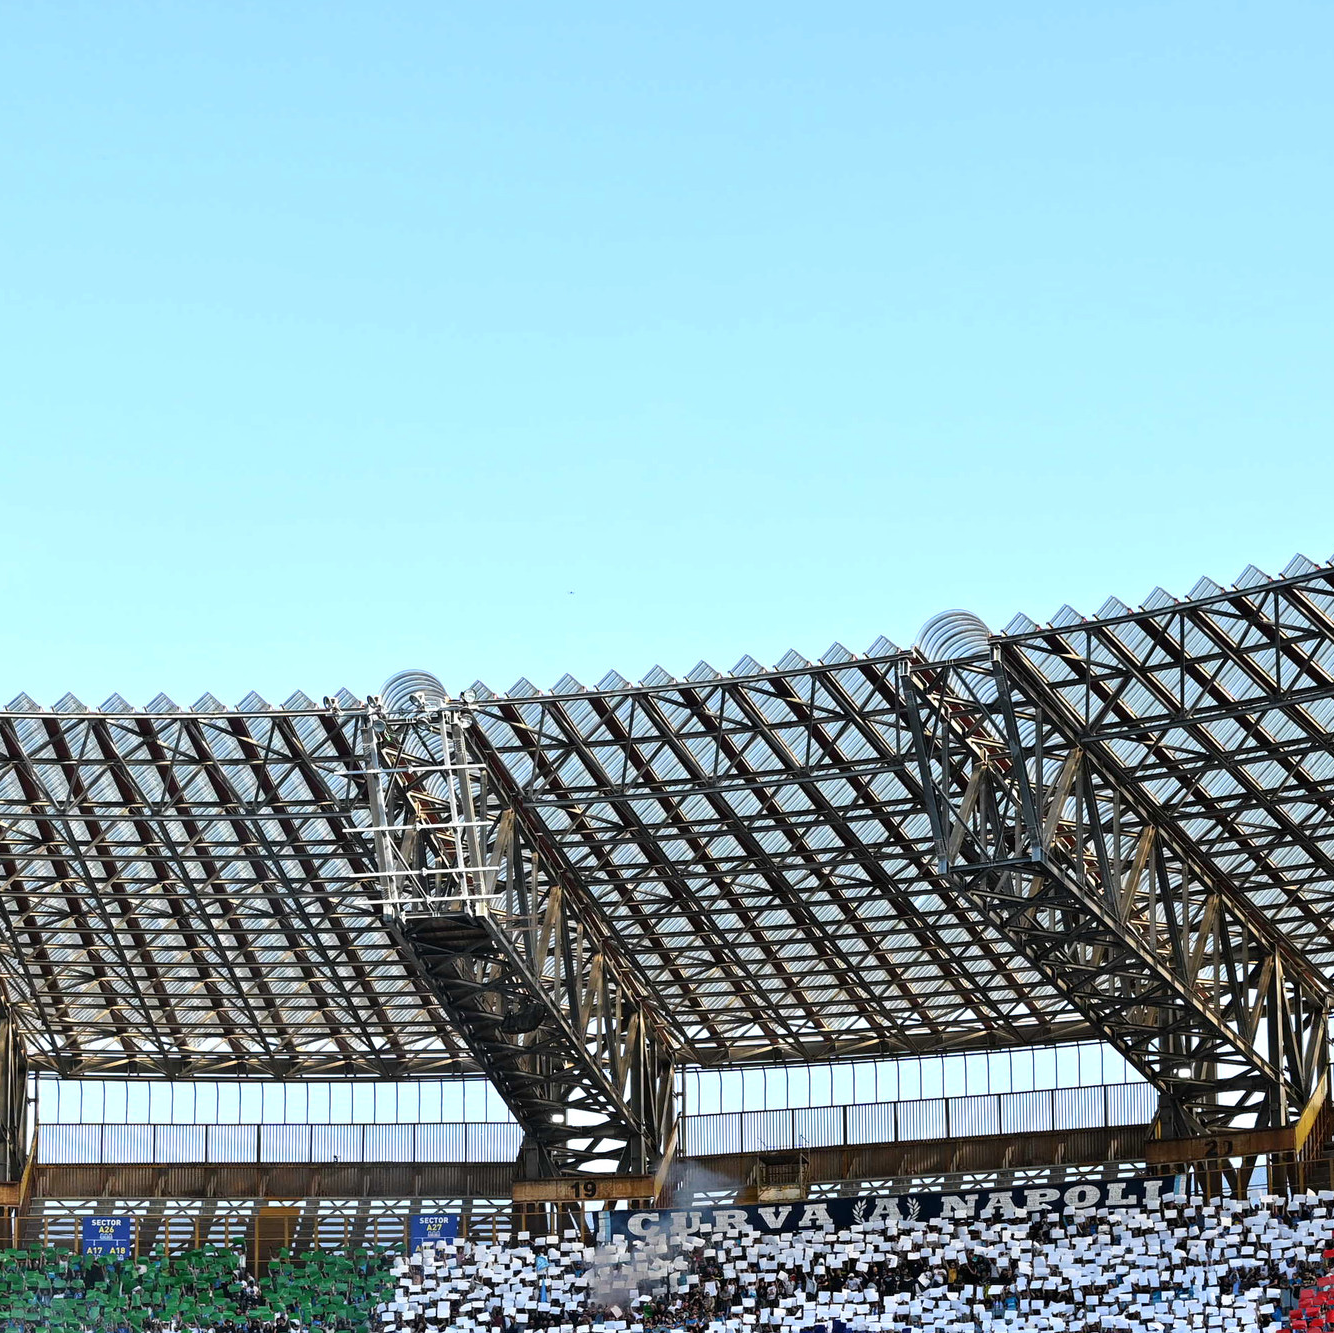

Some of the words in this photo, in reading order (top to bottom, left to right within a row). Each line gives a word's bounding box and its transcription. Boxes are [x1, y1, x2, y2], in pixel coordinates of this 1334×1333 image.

[571, 1181, 597, 1198] 19
[627, 1203, 833, 1237] CURVA
[871, 1197, 904, 1221] A
[940, 1180, 1163, 1219] NAPOLI
[98, 1226, 115, 1234] A26
